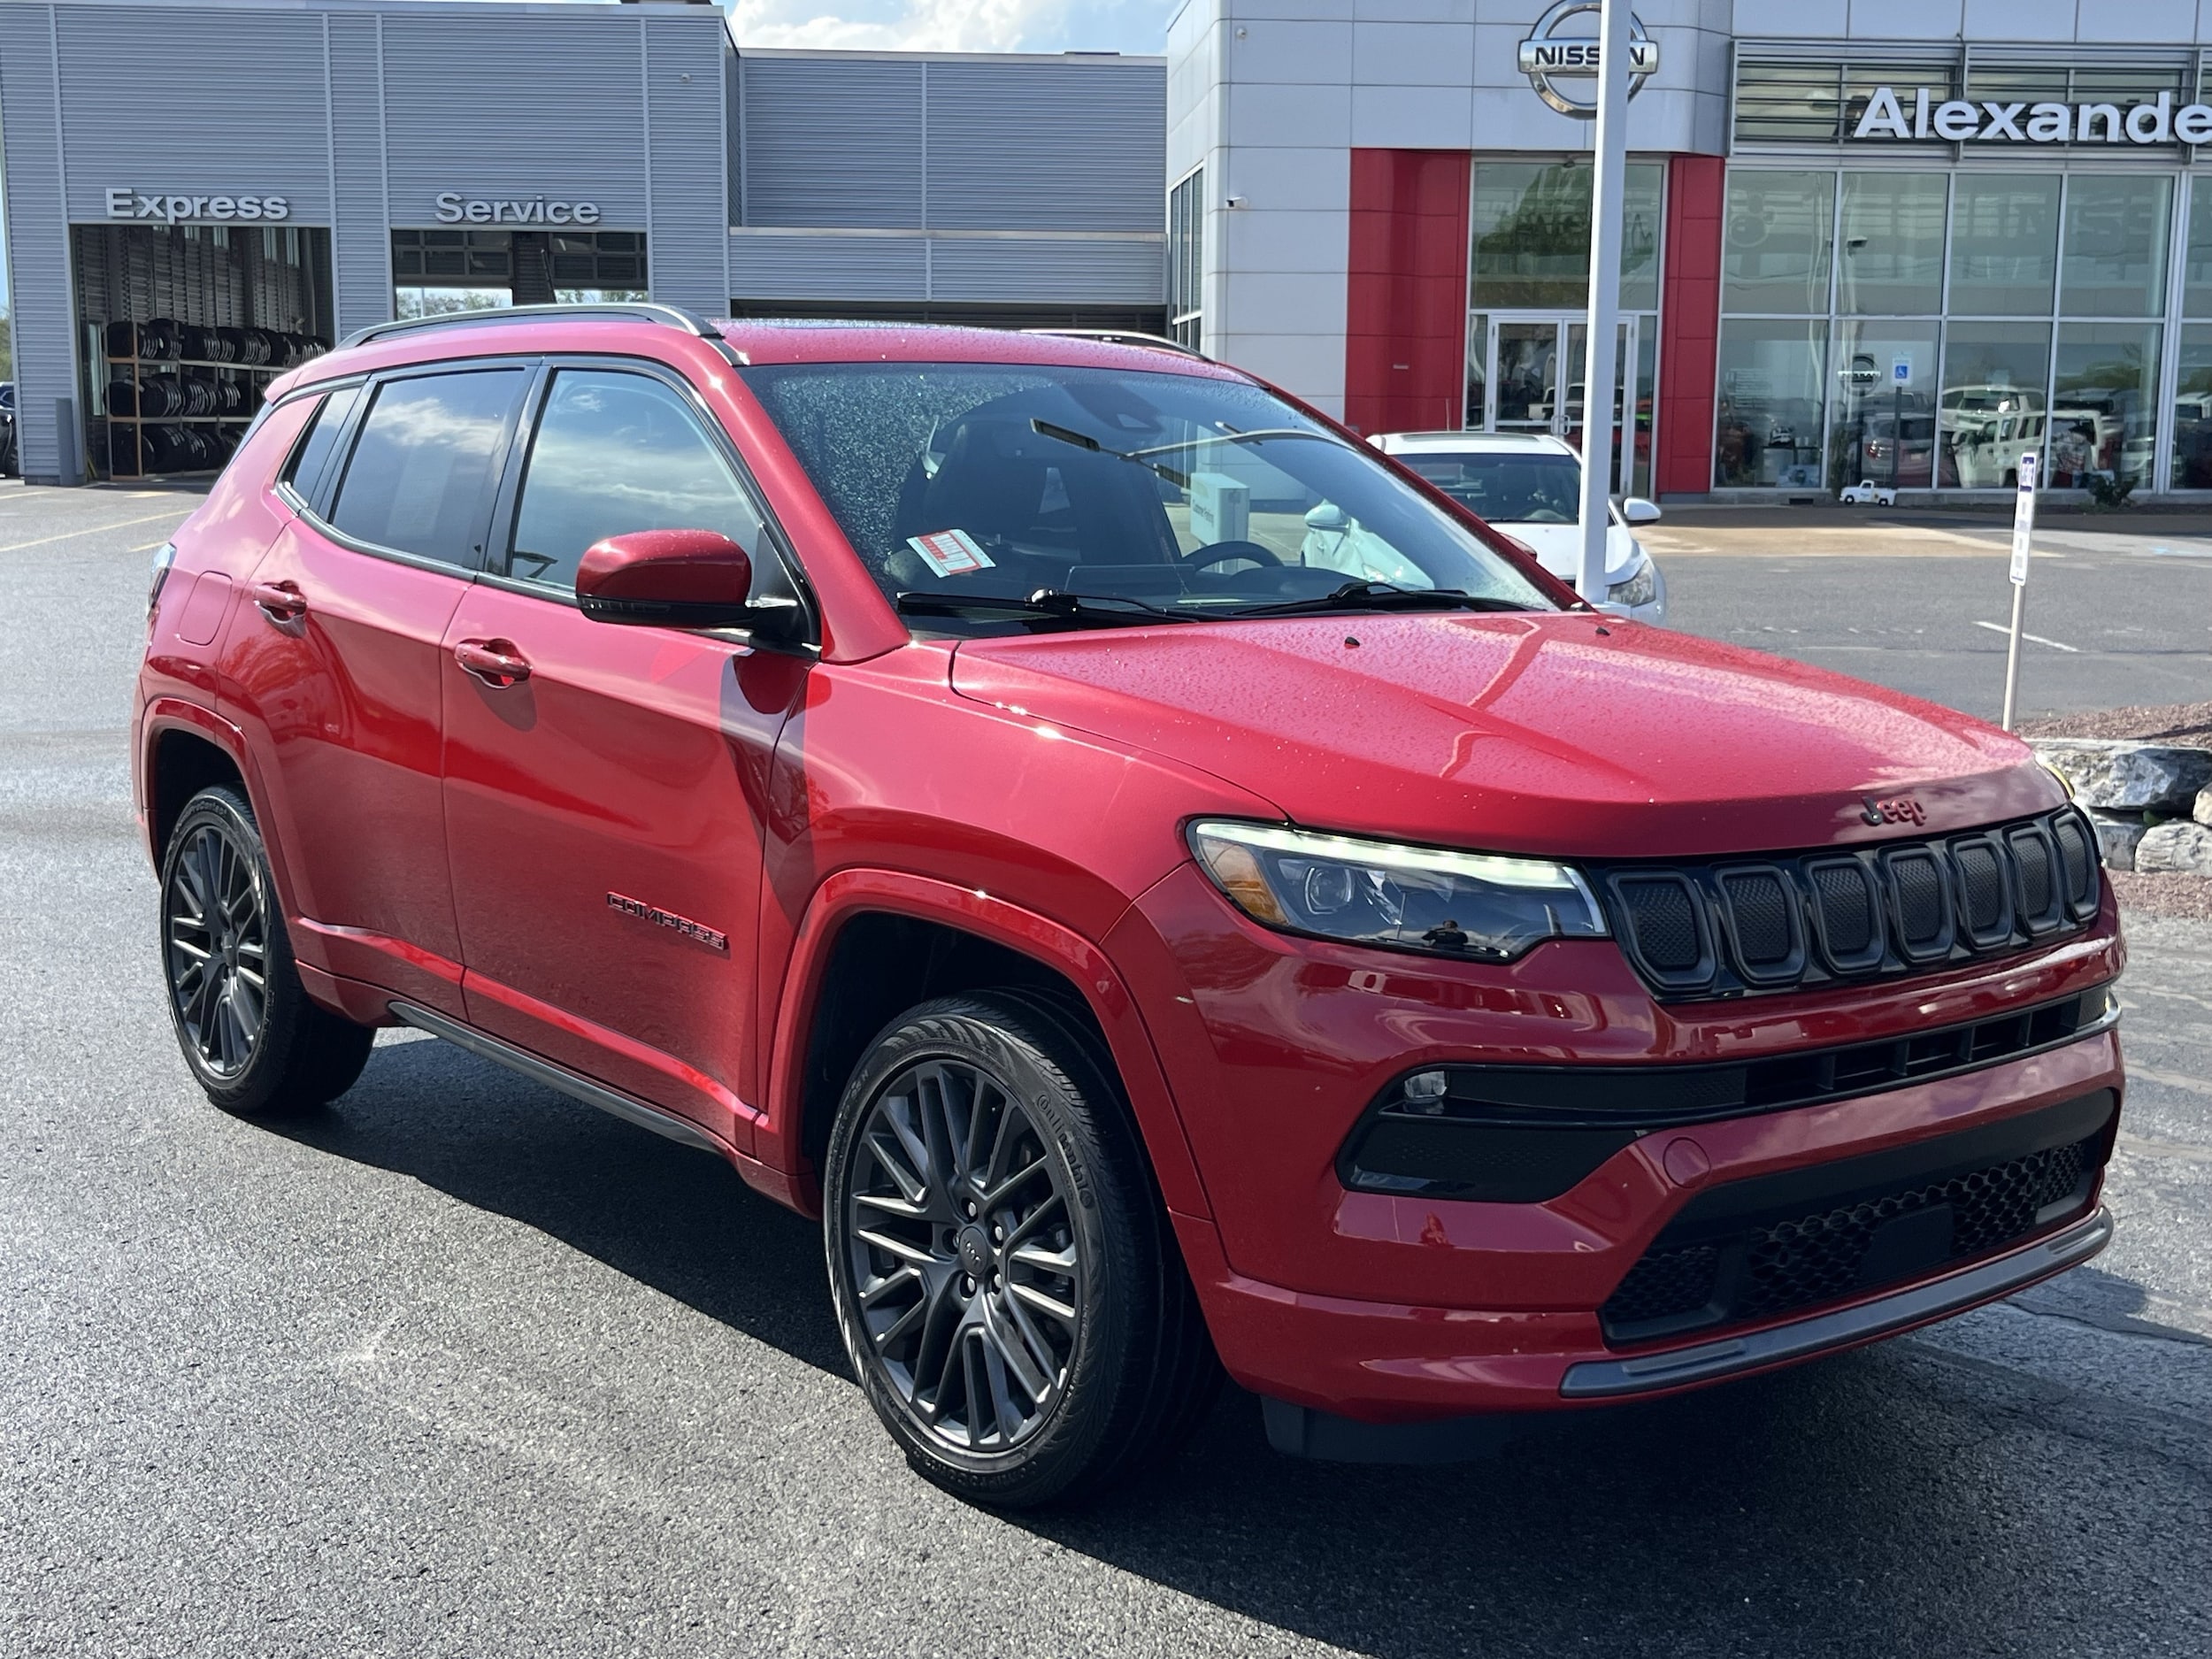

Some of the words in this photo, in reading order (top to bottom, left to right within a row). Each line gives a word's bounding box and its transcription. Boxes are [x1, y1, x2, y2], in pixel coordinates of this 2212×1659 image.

[1535, 46, 1646, 66] NISSN
[105, 187, 289, 225] Express
[434, 192, 600, 225] Service
[1859, 796, 1927, 827] Jeep
[606, 891, 727, 951] COMPASS
